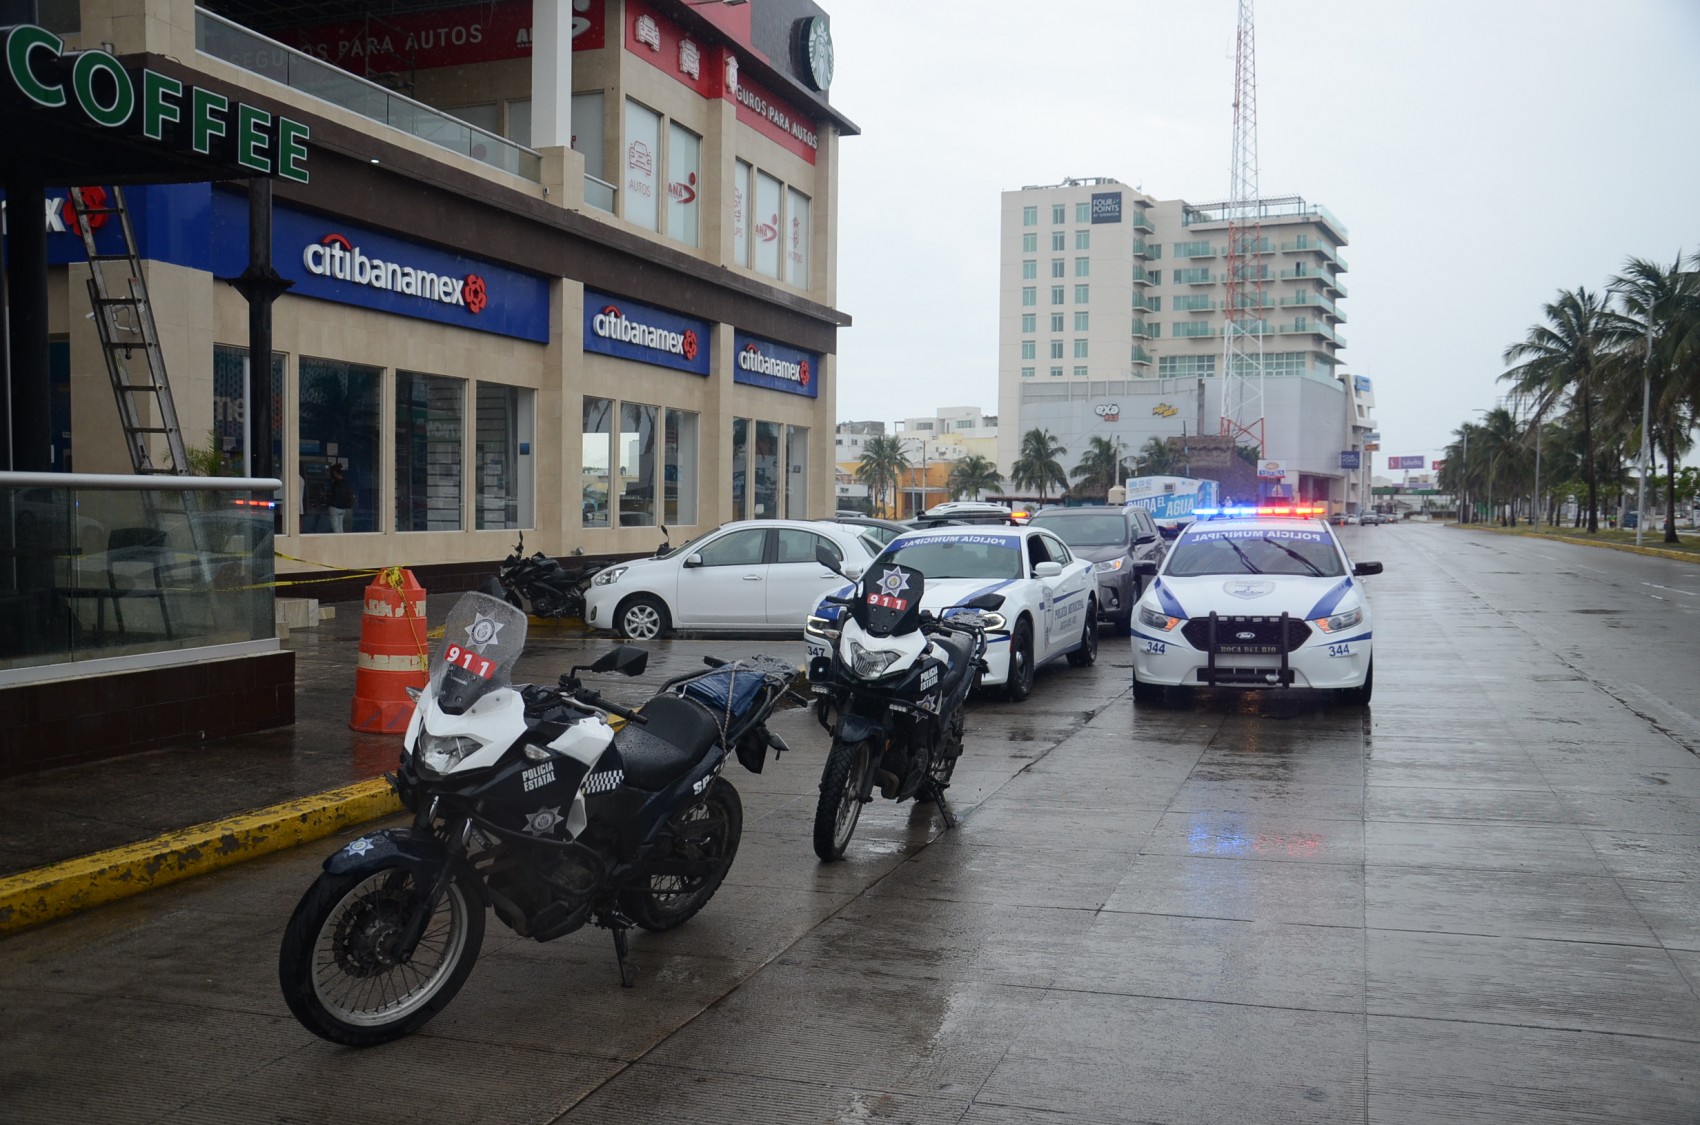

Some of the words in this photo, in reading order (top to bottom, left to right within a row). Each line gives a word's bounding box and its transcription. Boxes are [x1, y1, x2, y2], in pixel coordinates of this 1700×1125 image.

[338, 35, 394, 57] PARA
[405, 24, 483, 50] AUTOS
[7, 23, 310, 184] COFFEE
[736, 84, 767, 116] GUROS
[768, 106, 790, 132] PARA
[792, 122, 818, 149] AUTOS
[629, 178, 651, 197] AUTOS
[668, 182, 683, 199] ANA
[1093, 198, 1112, 206] FOUR
[1093, 204, 1119, 213] POINTS
[303, 240, 465, 306] citibanamex
[593, 310, 684, 355] citibanamex
[738, 349, 801, 382] citibanamex
[1095, 404, 1119, 417] exa
[1157, 496, 1166, 507] EL
[1166, 497, 1194, 517] AGUA
[869, 594, 903, 610] 911
[807, 645, 826, 657] 347
[1146, 641, 1166, 655] 344
[1328, 643, 1350, 657] 344
[446, 646, 490, 677] 911
[920, 674, 938, 692] ESTATAL
[521, 761, 554, 782] POLICIA
[523, 771, 556, 792] ESTATAL
